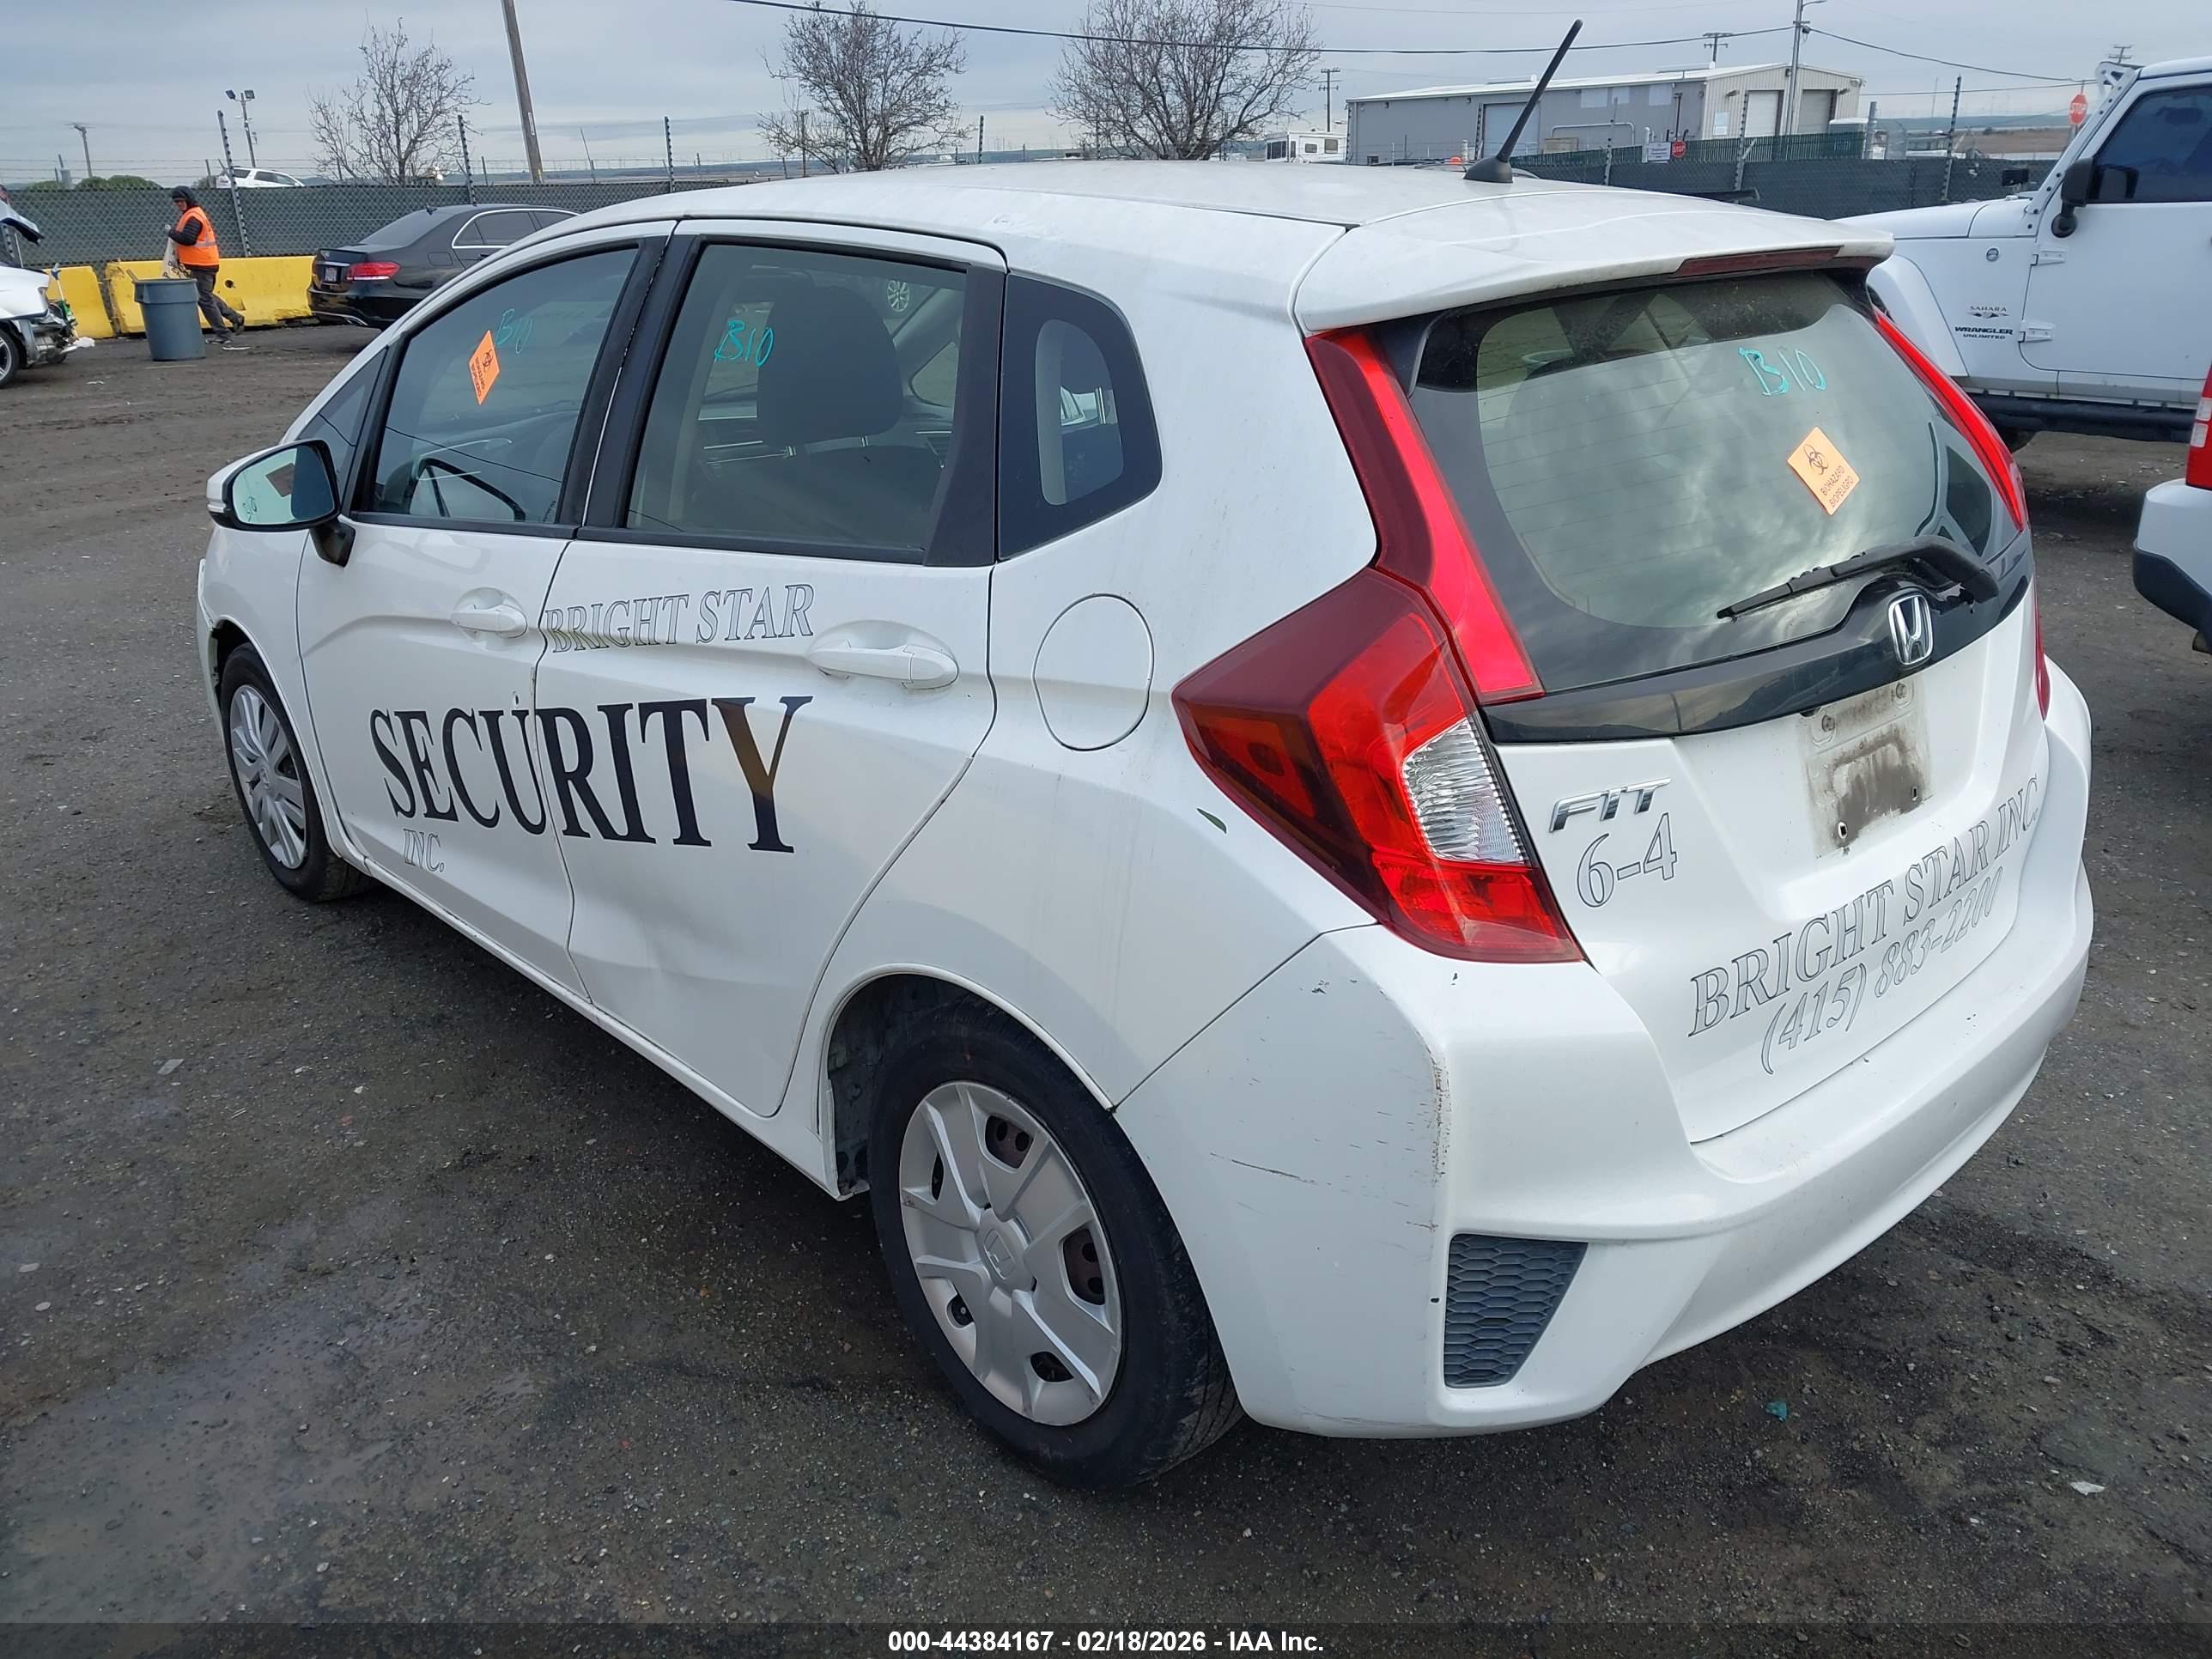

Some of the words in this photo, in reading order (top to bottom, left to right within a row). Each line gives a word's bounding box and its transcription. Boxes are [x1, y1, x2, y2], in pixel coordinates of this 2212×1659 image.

[1673, 144, 1685, 153] STOP
[1820, 465, 1846, 496] BIOHAZARD
[1829, 475, 1855, 507] BIOPELIGRO
[544, 593, 690, 653] BRIGHT
[696, 584, 815, 644] STAR
[369, 695, 814, 854] SECURITY
[1549, 777, 1671, 833] FIT
[403, 828, 445, 873] INC.
[1577, 812, 1678, 908] 6-4
[1688, 879, 1894, 1037] BRIGHT
[1902, 818, 1990, 927] STAR
[1994, 773, 2040, 862] INC.
[1760, 963, 1868, 1075] (415)
[1874, 866, 2004, 999] 883-2200
